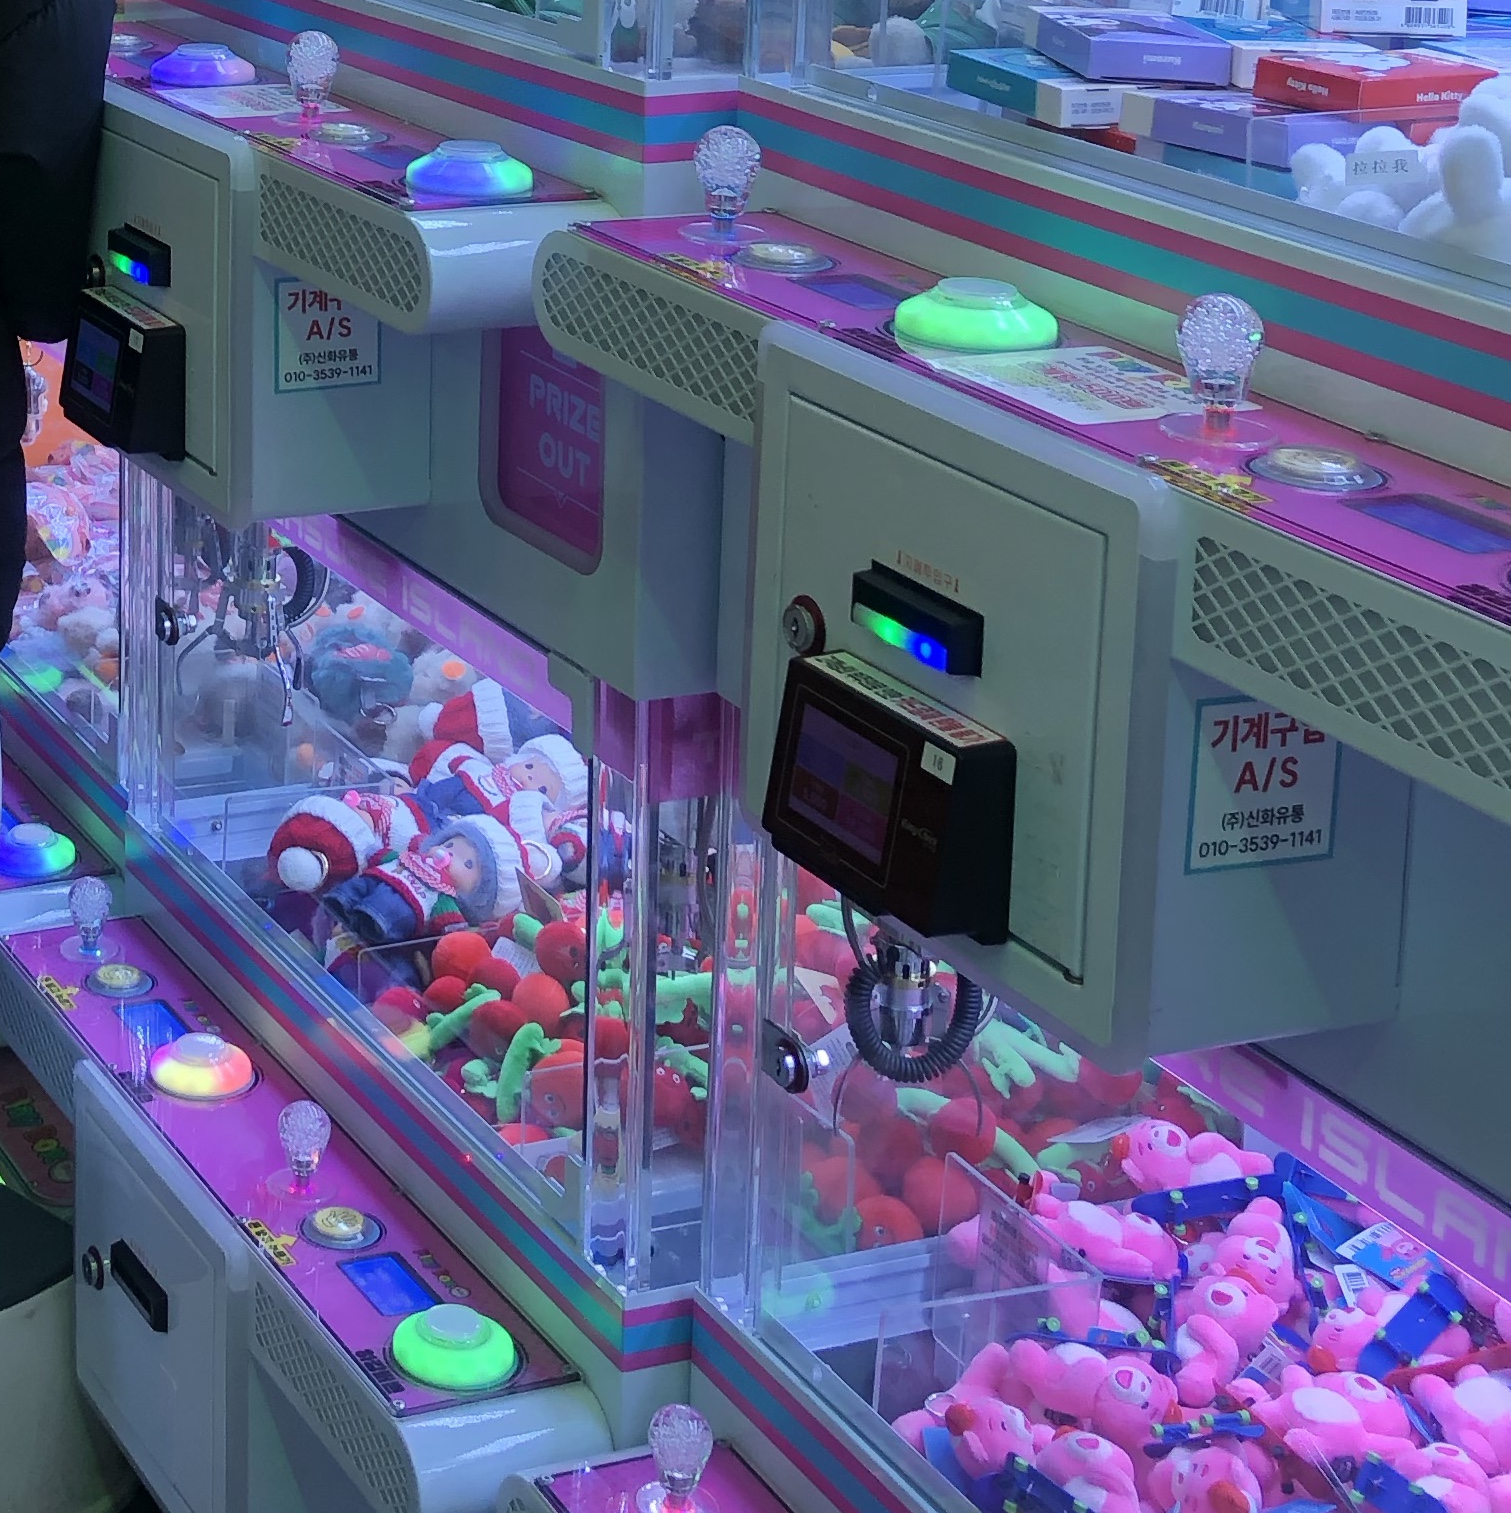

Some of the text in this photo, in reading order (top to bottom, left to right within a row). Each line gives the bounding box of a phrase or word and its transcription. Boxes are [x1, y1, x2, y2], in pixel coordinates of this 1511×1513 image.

[1416, 90, 1463, 103] Hello Kitty
[1352, 157, 1410, 175] 拉拉我
[306, 317, 352, 341] A/S
[284, 365, 373, 383] 010-3539-1141
[529, 373, 601, 443] PRIZE
[538, 431, 591, 488] OUT
[1234, 756, 1299, 794] A/S
[1221, 804, 1305, 831] (주)신화유통
[1199, 829, 1322, 858] 010-3539-1141
